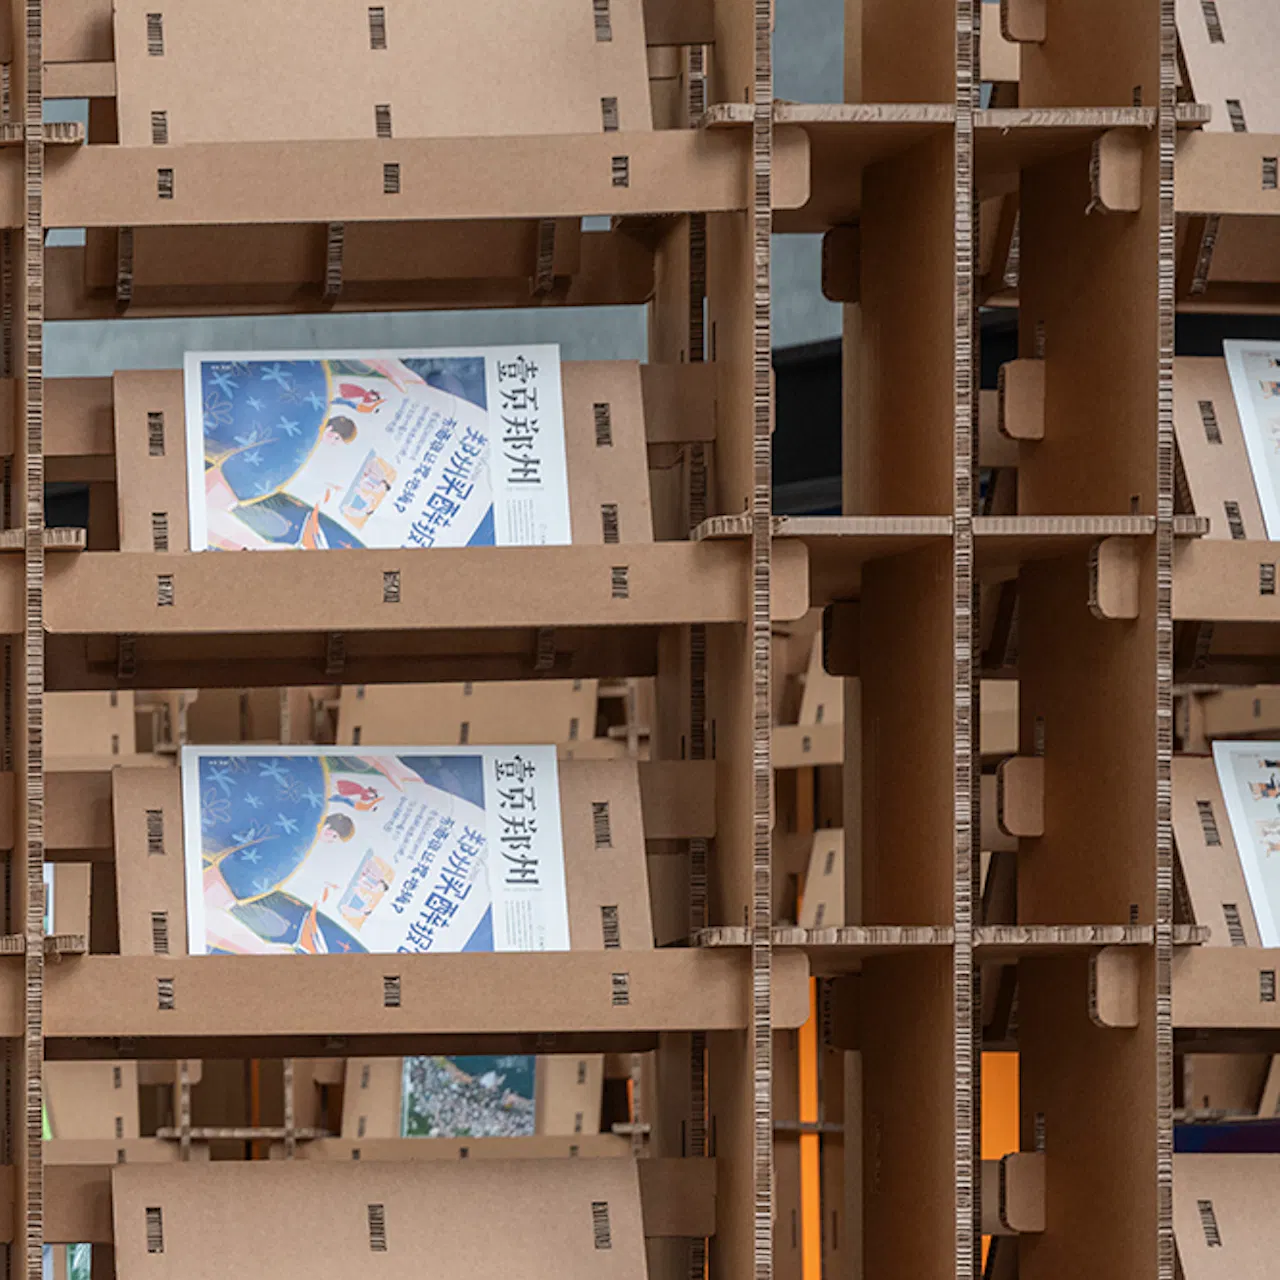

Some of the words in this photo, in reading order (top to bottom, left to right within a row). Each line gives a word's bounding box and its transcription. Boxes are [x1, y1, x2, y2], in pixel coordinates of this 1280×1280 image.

[496, 355, 541, 485] 壹页郑州
[493, 754, 540, 885] 壹页郑州
